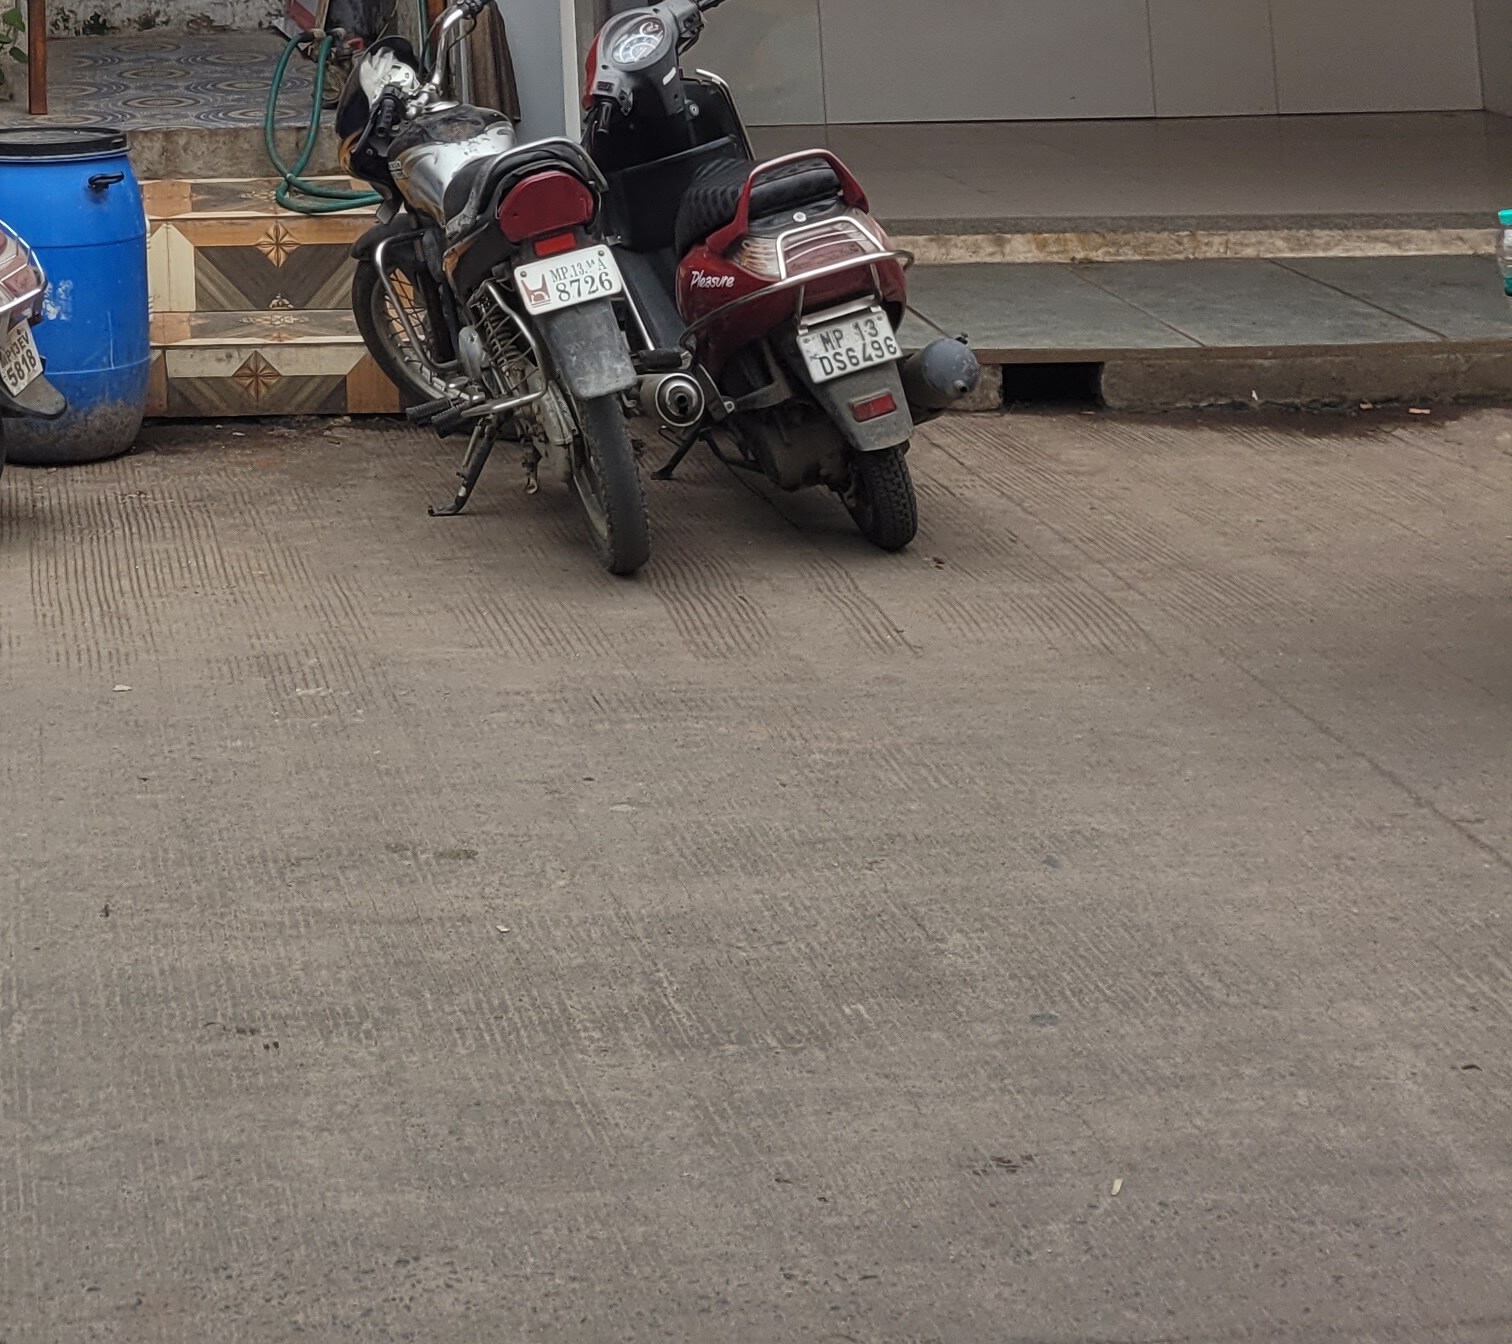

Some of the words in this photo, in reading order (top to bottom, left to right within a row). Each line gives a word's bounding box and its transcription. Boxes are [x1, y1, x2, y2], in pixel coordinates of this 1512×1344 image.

[556, 271, 613, 302] 8726
[690, 269, 735, 291] Pleasure
[820, 329, 844, 352] MP
[852, 319, 879, 341] 13
[6, 349, 37, 387] 5818
